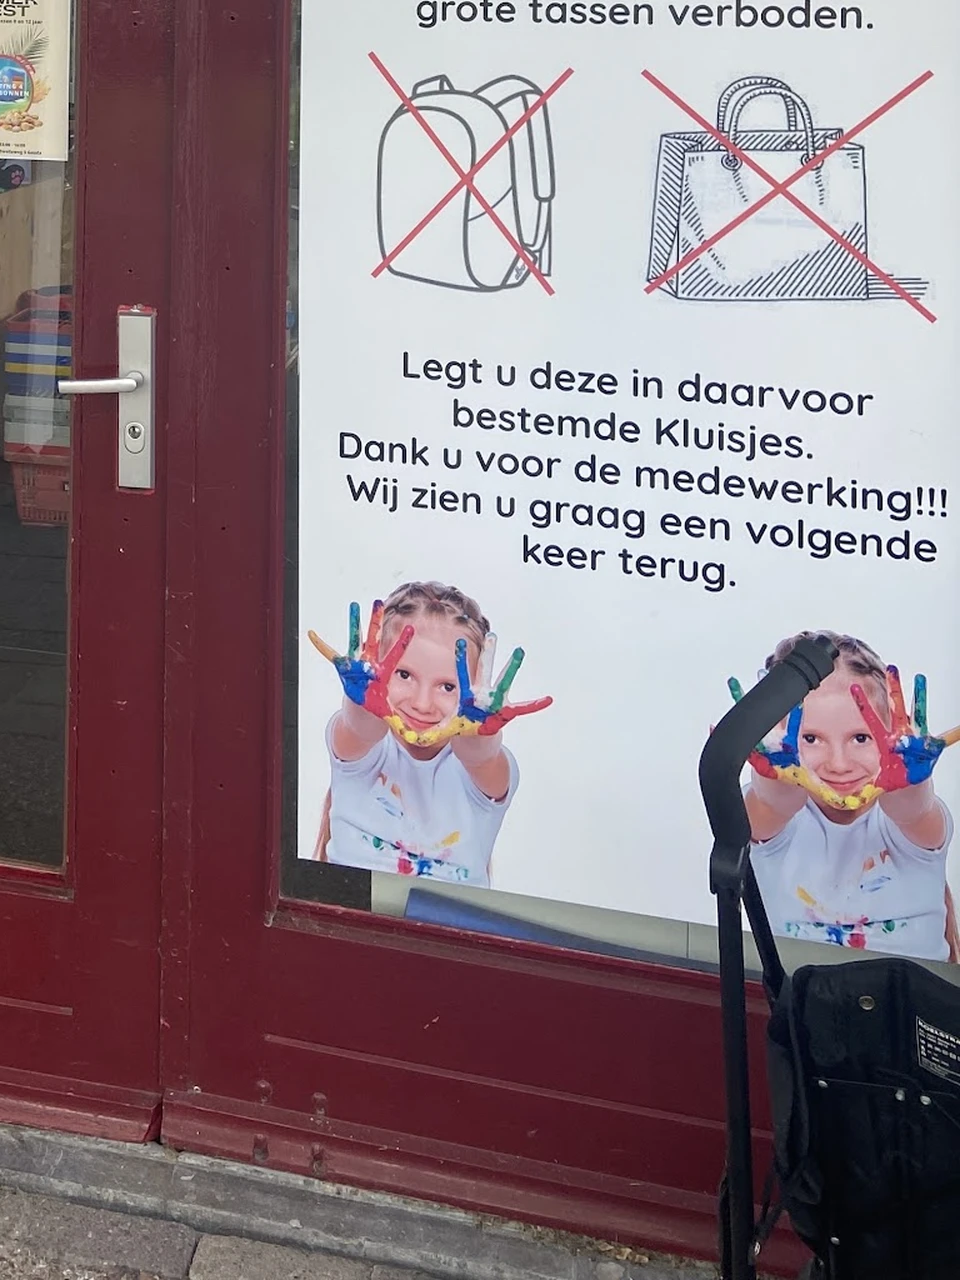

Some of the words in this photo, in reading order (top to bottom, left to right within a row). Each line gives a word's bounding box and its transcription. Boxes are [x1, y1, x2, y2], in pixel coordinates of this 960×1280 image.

[401, 351, 483, 389] Legt
[496, 364, 517, 388] u
[529, 361, 619, 396] deze
[632, 368, 664, 400] in
[677, 373, 875, 417] daarvoor
[452, 398, 640, 443] bestemde
[654, 417, 815, 463] Kluisjes.
[338, 431, 430, 467] Dank
[443, 446, 463, 470] u
[476, 450, 562, 480] voor
[574, 454, 621, 485] de
[634, 463, 949, 521] medewerking!!!
[345, 474, 399, 513] Wij
[411, 481, 483, 516] zien
[495, 495, 516, 519] u
[529, 496, 646, 539] graag
[660, 513, 732, 542] een
[745, 519, 939, 564] volgende
[521, 533, 607, 572] keer
[618, 547, 738, 594] terug.
